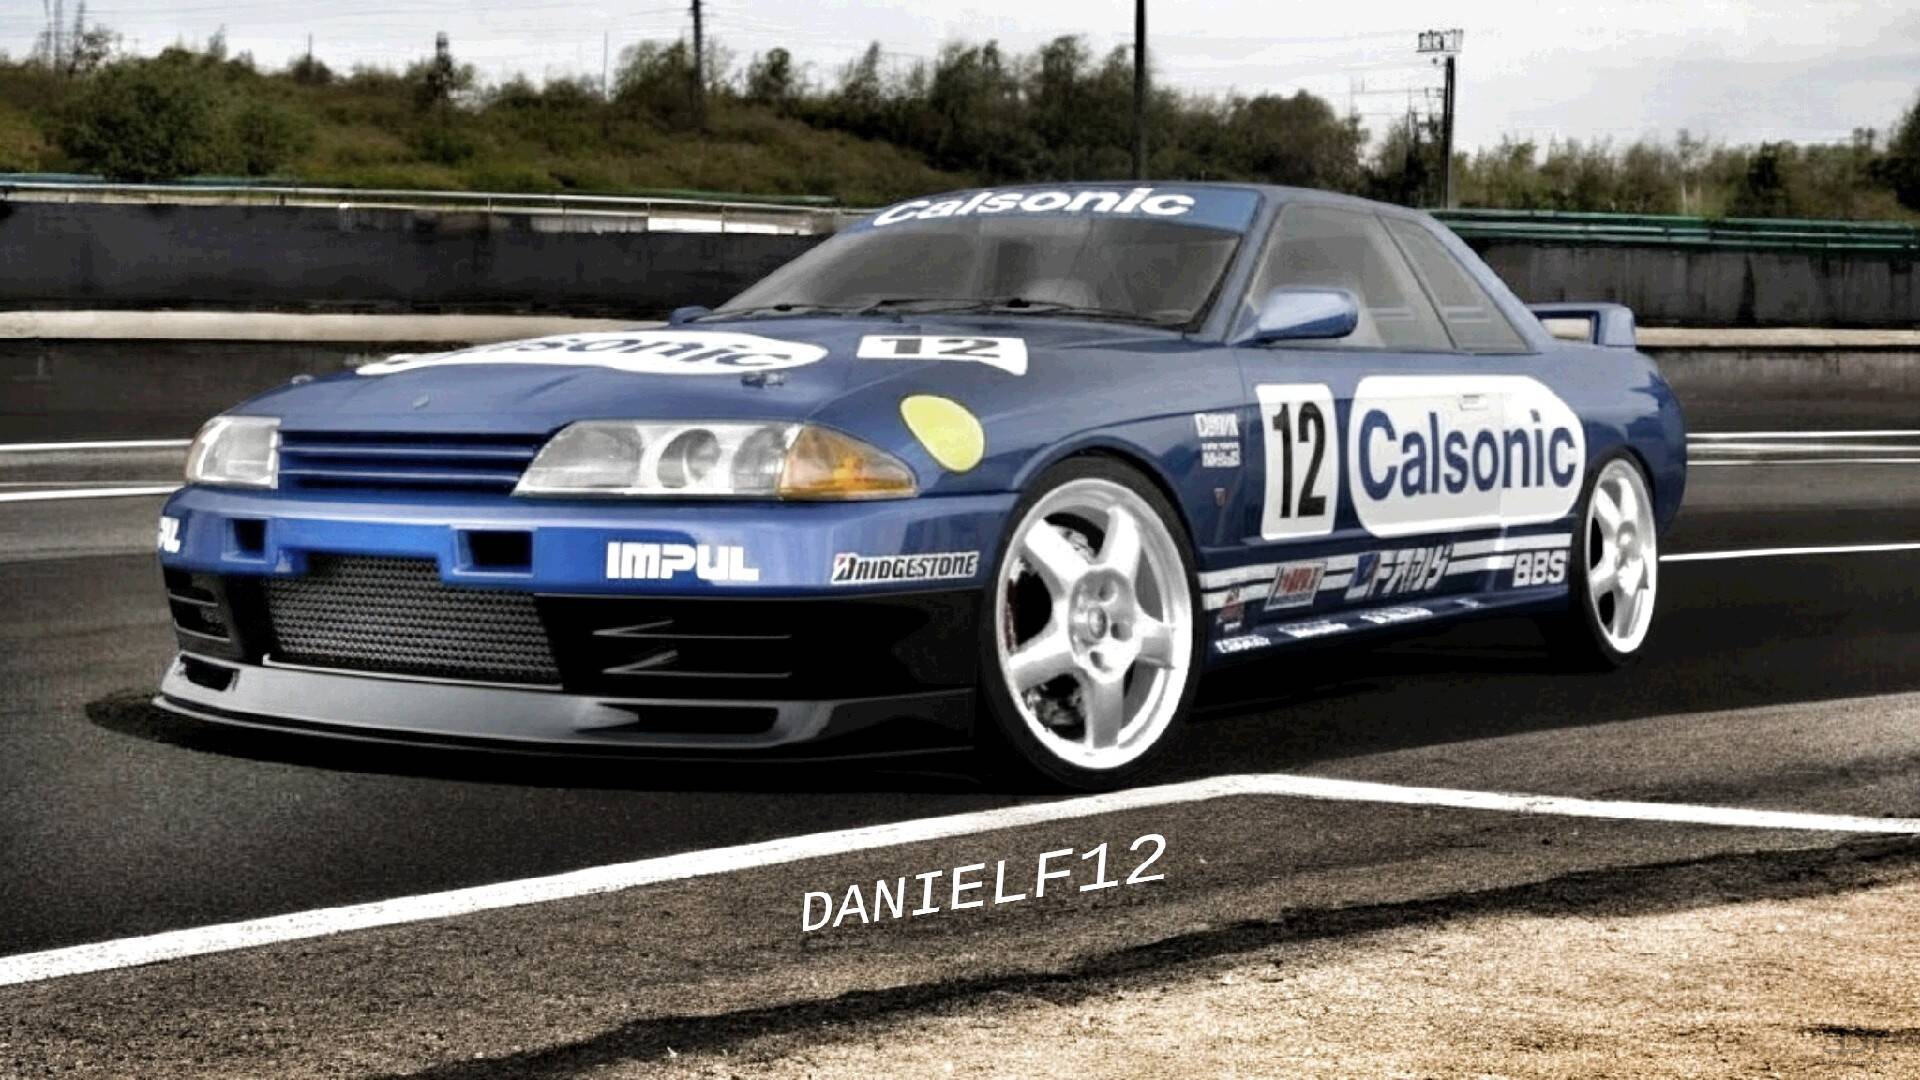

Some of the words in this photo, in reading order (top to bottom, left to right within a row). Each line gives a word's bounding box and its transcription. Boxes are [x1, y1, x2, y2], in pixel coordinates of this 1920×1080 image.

[873, 188, 1195, 226] Calsonic
[881, 338, 1000, 358] 12
[1273, 401, 1326, 518] 12
[1359, 409, 1577, 500] Calsonic
[606, 542, 759, 581] IMPUL
[834, 553, 978, 582] BRIDGESTONE
[1513, 550, 1568, 588] BBS
